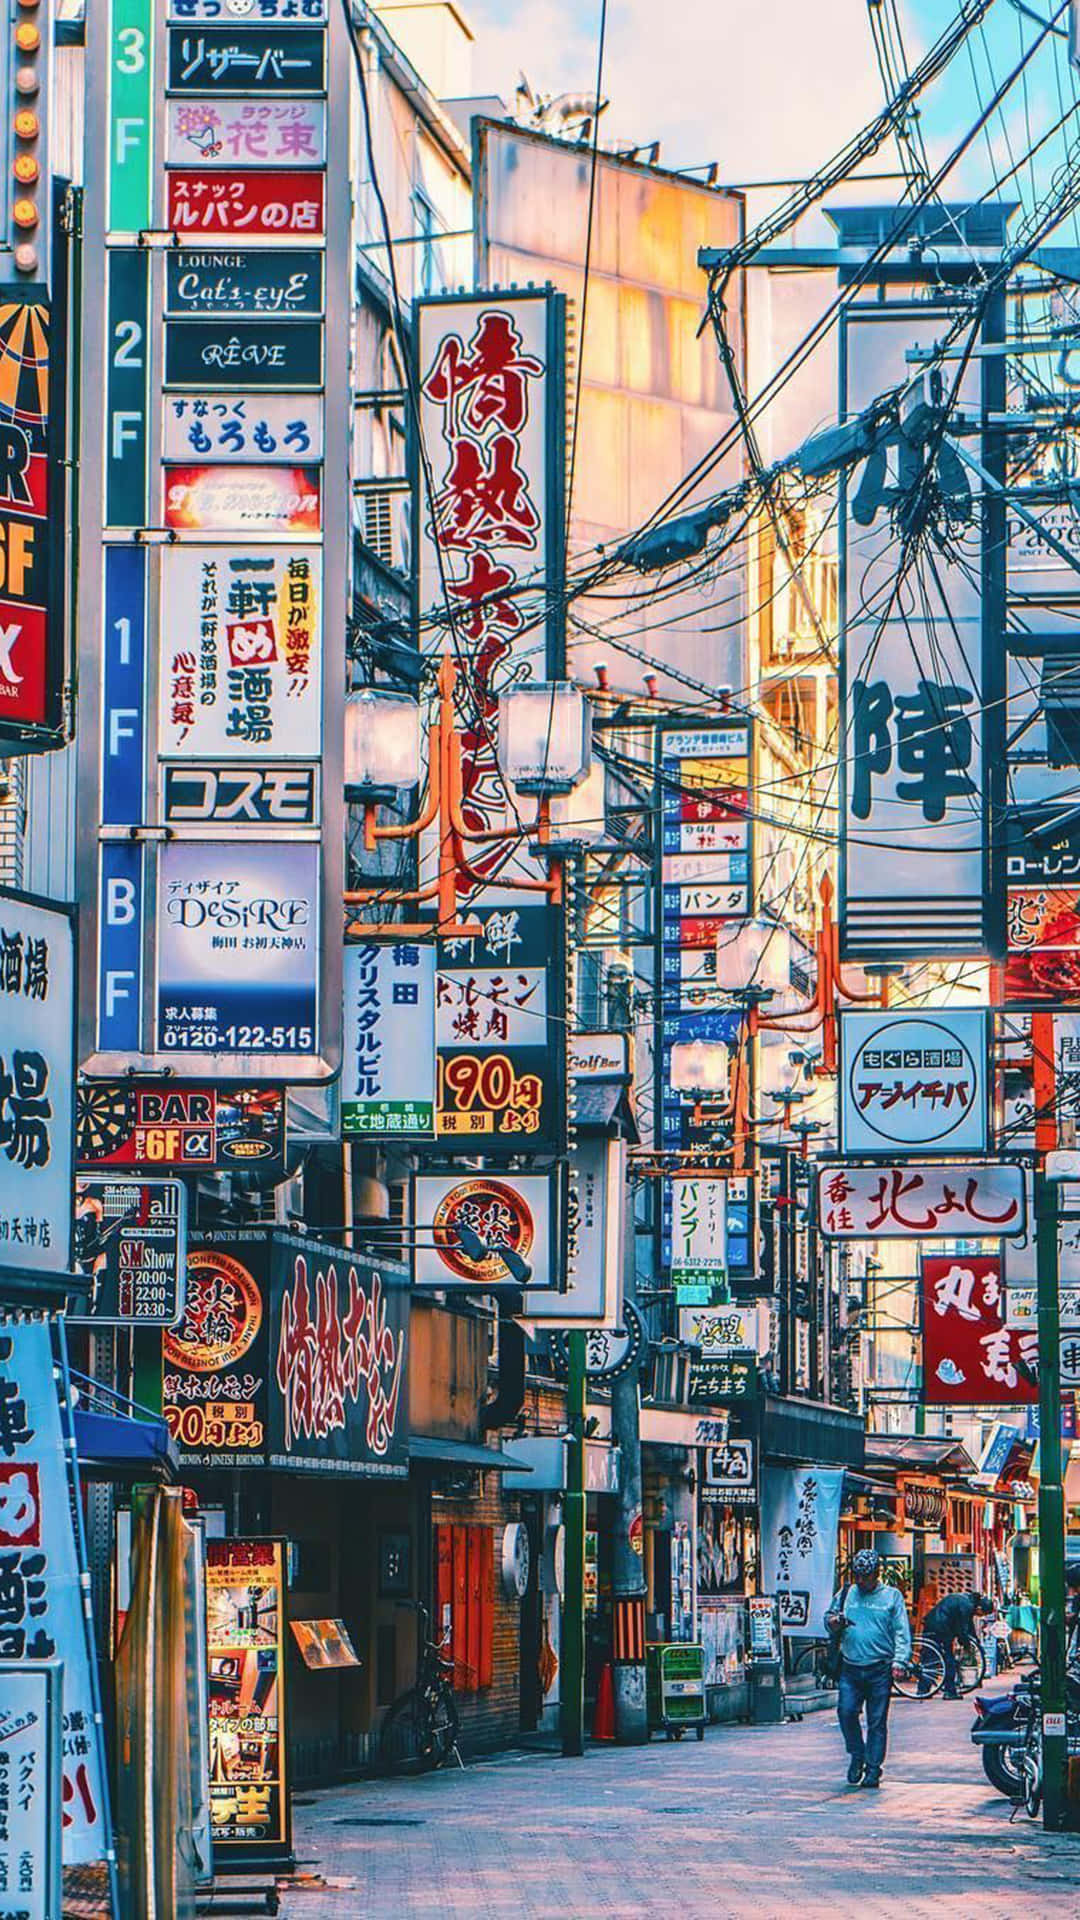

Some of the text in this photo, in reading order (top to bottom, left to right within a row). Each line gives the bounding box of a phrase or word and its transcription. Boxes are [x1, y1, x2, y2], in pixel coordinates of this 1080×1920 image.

[181, 37, 313, 80] リザーバー
[242, 106, 306, 119] ラウンジ
[227, 121, 318, 157] 花束
[174, 181, 245, 198] スナック
[173, 200, 319, 229] ルパンの店
[178, 255, 247, 268] LOUNGE
[172, 400, 247, 418] すなっく
[189, 420, 311, 453] もろもろ
[226, 558, 279, 744] 一軒め酒場
[169, 770, 310, 819] コスモ
[167, 879, 240, 896] ディザイア
[685, 892, 745, 909] パンダ
[212, 936, 307, 950] 梅田 お初天神店
[392, 944, 420, 1005] 梅田
[165, 1007, 217, 1021] 求人募集
[355, 944, 382, 1098] クリスタルビル
[452, 1008, 508, 1042] 焼肉
[164, 1027, 311, 1049] 0120-122-515
[863, 1051, 963, 1069] もぐら酒場
[140, 1094, 214, 1125] BAR
[343, 1113, 430, 1131] ごて地蔵通り
[443, 1115, 486, 1131] 税別
[146, 1129, 180, 1161] 6F
[866, 1169, 1018, 1230] 北よし
[680, 1183, 700, 1257] バンブー
[707, 1184, 718, 1244] サントリー
[690, 1376, 746, 1396] たちまち
[212, 1405, 248, 1419] 税別
[713, 1447, 748, 1475] 牛角
